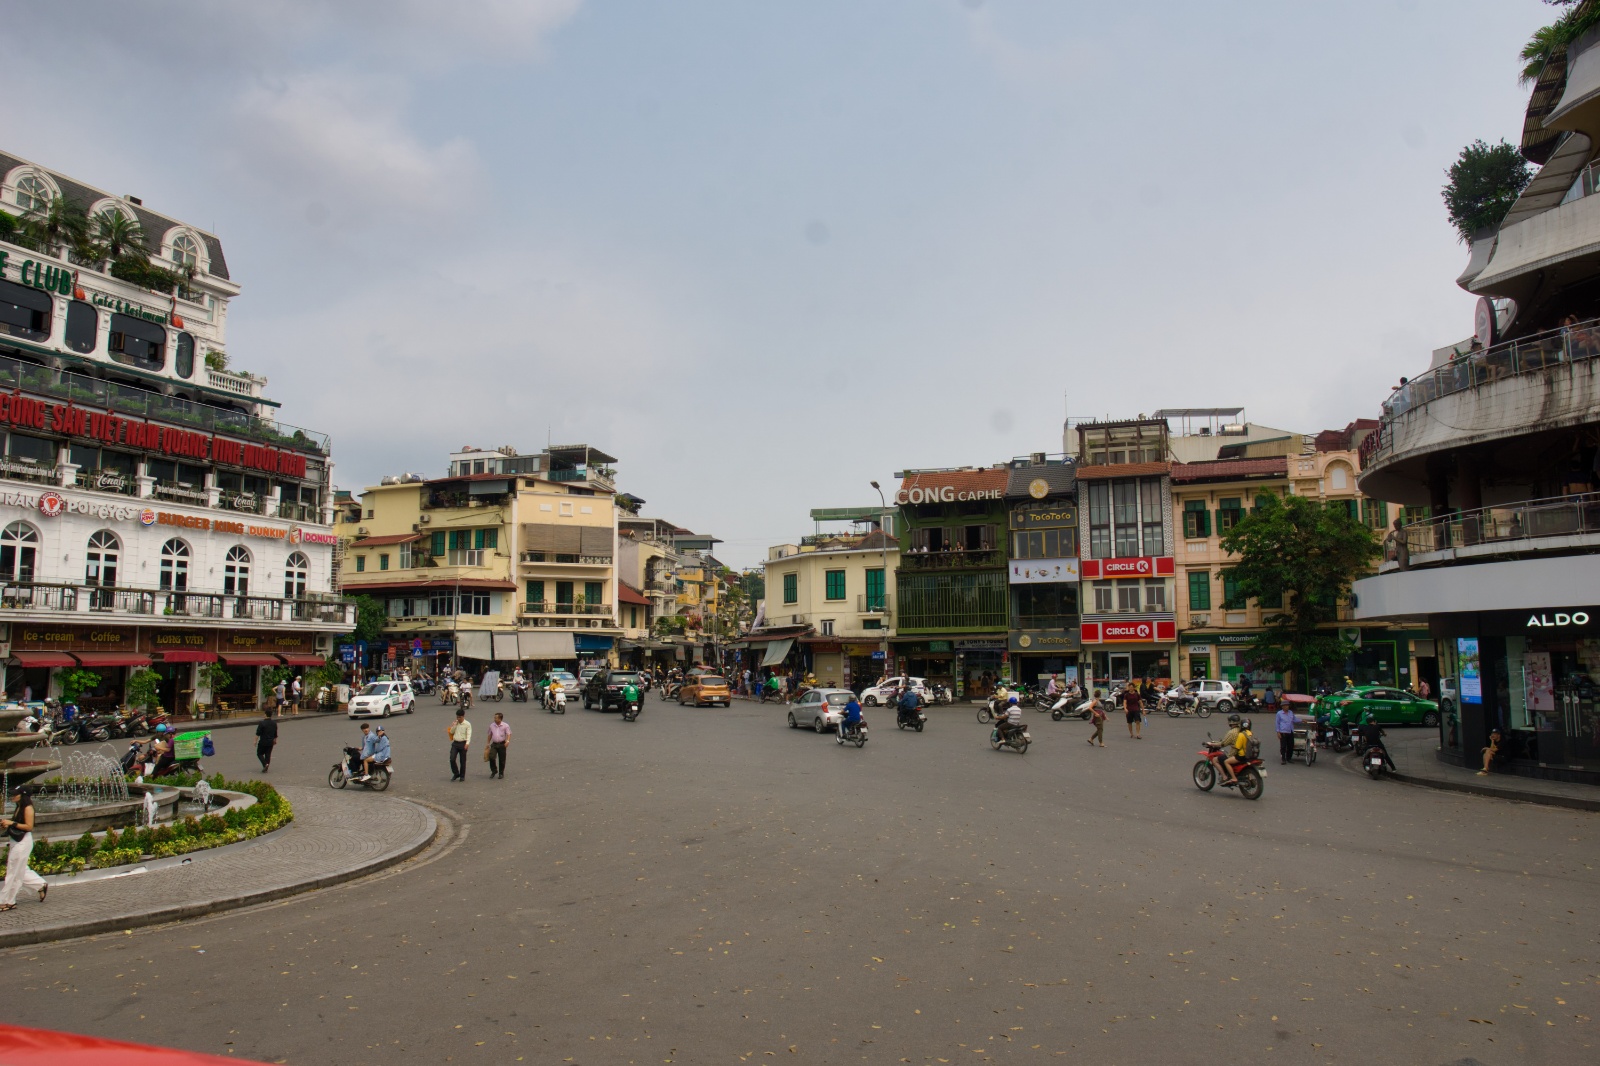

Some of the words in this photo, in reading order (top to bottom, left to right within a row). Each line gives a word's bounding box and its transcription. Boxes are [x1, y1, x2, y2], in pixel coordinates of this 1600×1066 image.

[22, 259, 72, 296] CLUB
[115, 300, 122, 312] &
[124, 302, 168, 324] Restaurant
[90, 408, 124, 446] VIỆT
[125, 420, 161, 450] NAM
[162, 427, 207, 458] QUANG
[211, 437, 242, 466] VINH
[243, 442, 279, 473] MUÔN
[279, 448, 307, 478] NĂM
[158, 512, 210, 531] BURGER
[214, 520, 244, 535] KING
[249, 525, 288, 539] DUNKIN'
[305, 532, 337, 545] DONUTS
[1106, 563, 1134, 571] CIRCLE
[1527, 612, 1590, 627] ALDO
[91, 631, 121, 642] Coffee
[1106, 627, 1135, 636] CIRCLE
[233, 635, 257, 646] Burger
[274, 636, 301, 646] Fastfood
